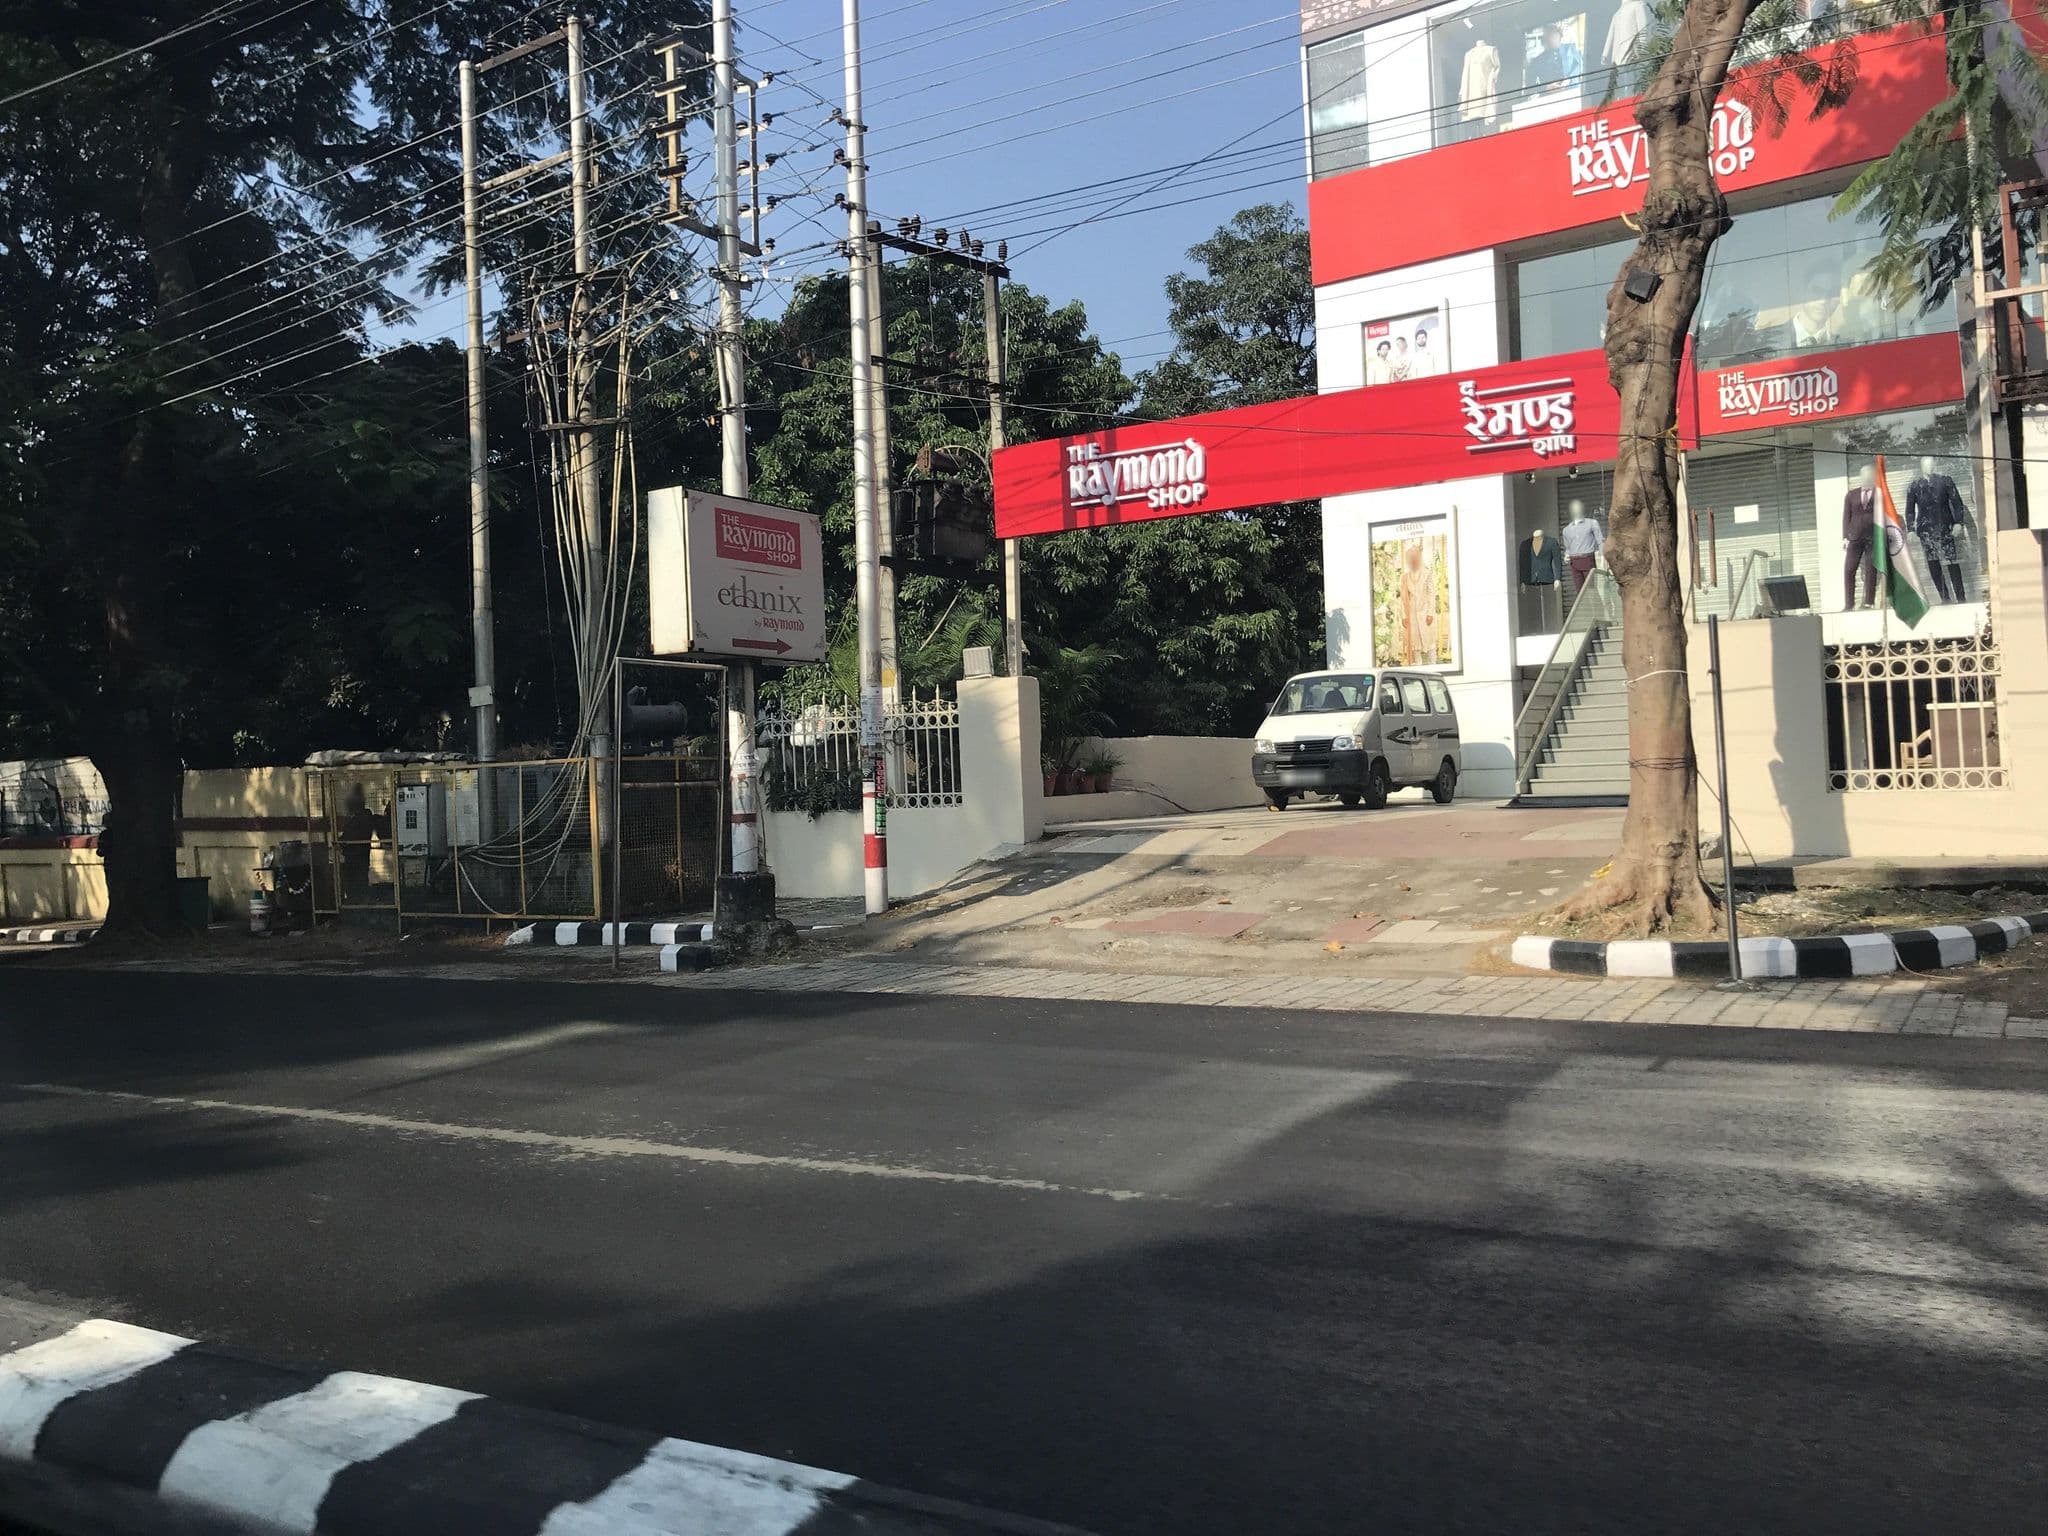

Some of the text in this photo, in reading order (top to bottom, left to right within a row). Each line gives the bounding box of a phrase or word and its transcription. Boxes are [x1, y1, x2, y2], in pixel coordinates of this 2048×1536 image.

[1567, 119, 1609, 147] THE
[1567, 98, 1754, 189] Raynd
[1458, 380, 1476, 397] द
[1718, 371, 1745, 385] THE
[1717, 366, 1838, 415] Raymond
[1788, 397, 1839, 417] SHOP
[1066, 442, 1100, 463] THE
[1067, 437, 1206, 506] Raymond
[1147, 482, 1209, 509] SHOP
[721, 513, 740, 526] THE
[721, 524, 796, 553] Raymond
[766, 551, 797, 564] SHOP
[717, 575, 804, 615] ethnix
[762, 617, 805, 632] Raymond
